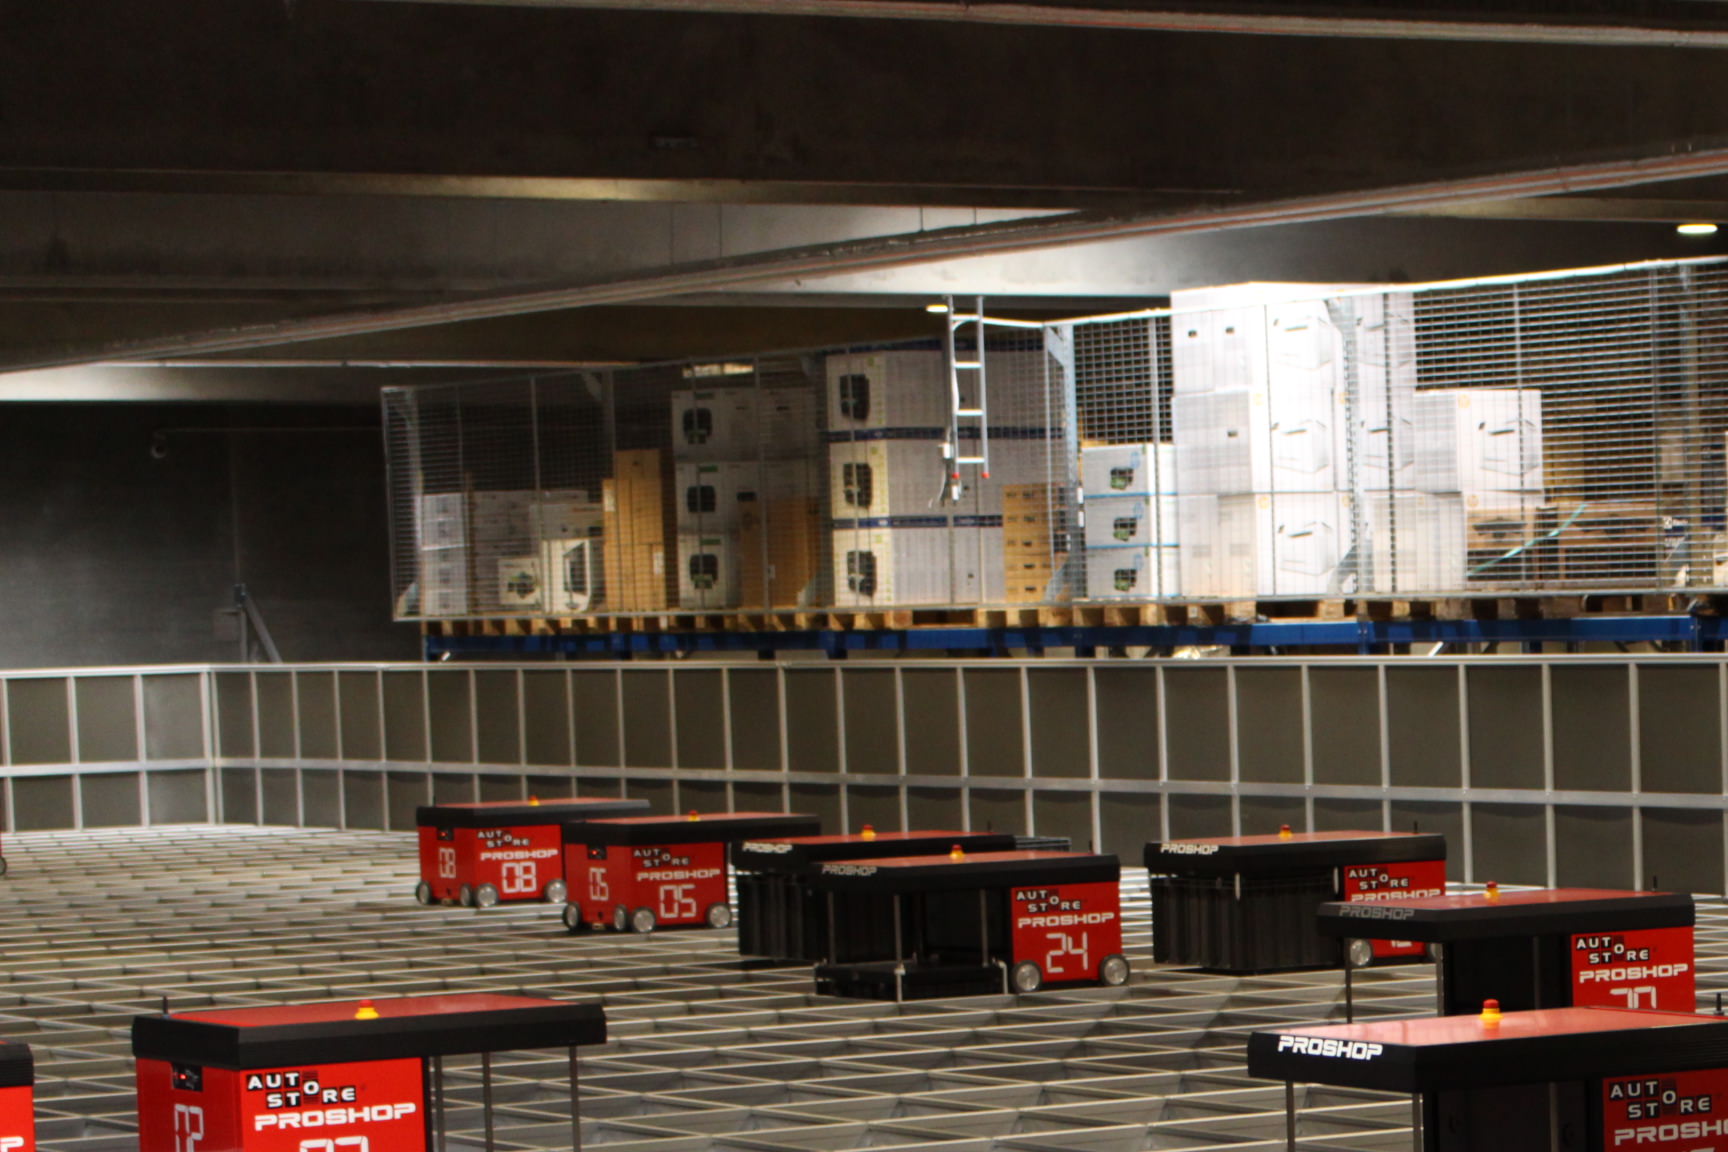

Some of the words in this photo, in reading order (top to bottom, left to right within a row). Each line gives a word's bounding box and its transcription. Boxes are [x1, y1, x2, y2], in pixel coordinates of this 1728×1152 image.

[480, 849, 559, 861] PROSHOP
[742, 841, 793, 854] PROSHOP
[1161, 843, 1219, 855] PROSHOP
[439, 848, 456, 878] 08
[822, 864, 877, 876] PROSHOP
[502, 861, 537, 893] 08
[589, 867, 609, 901] 05
[637, 869, 721, 882] PROSHOP
[660, 884, 696, 918] 05
[1018, 912, 1115, 928] PROSHOP
[1339, 905, 1415, 920] PROSHOP
[1046, 931, 1088, 973] 24
[1579, 963, 1688, 984] PROSHOP
[1277, 1035, 1383, 1060] PROSHOP
[254, 1103, 416, 1131] PROSHOP
